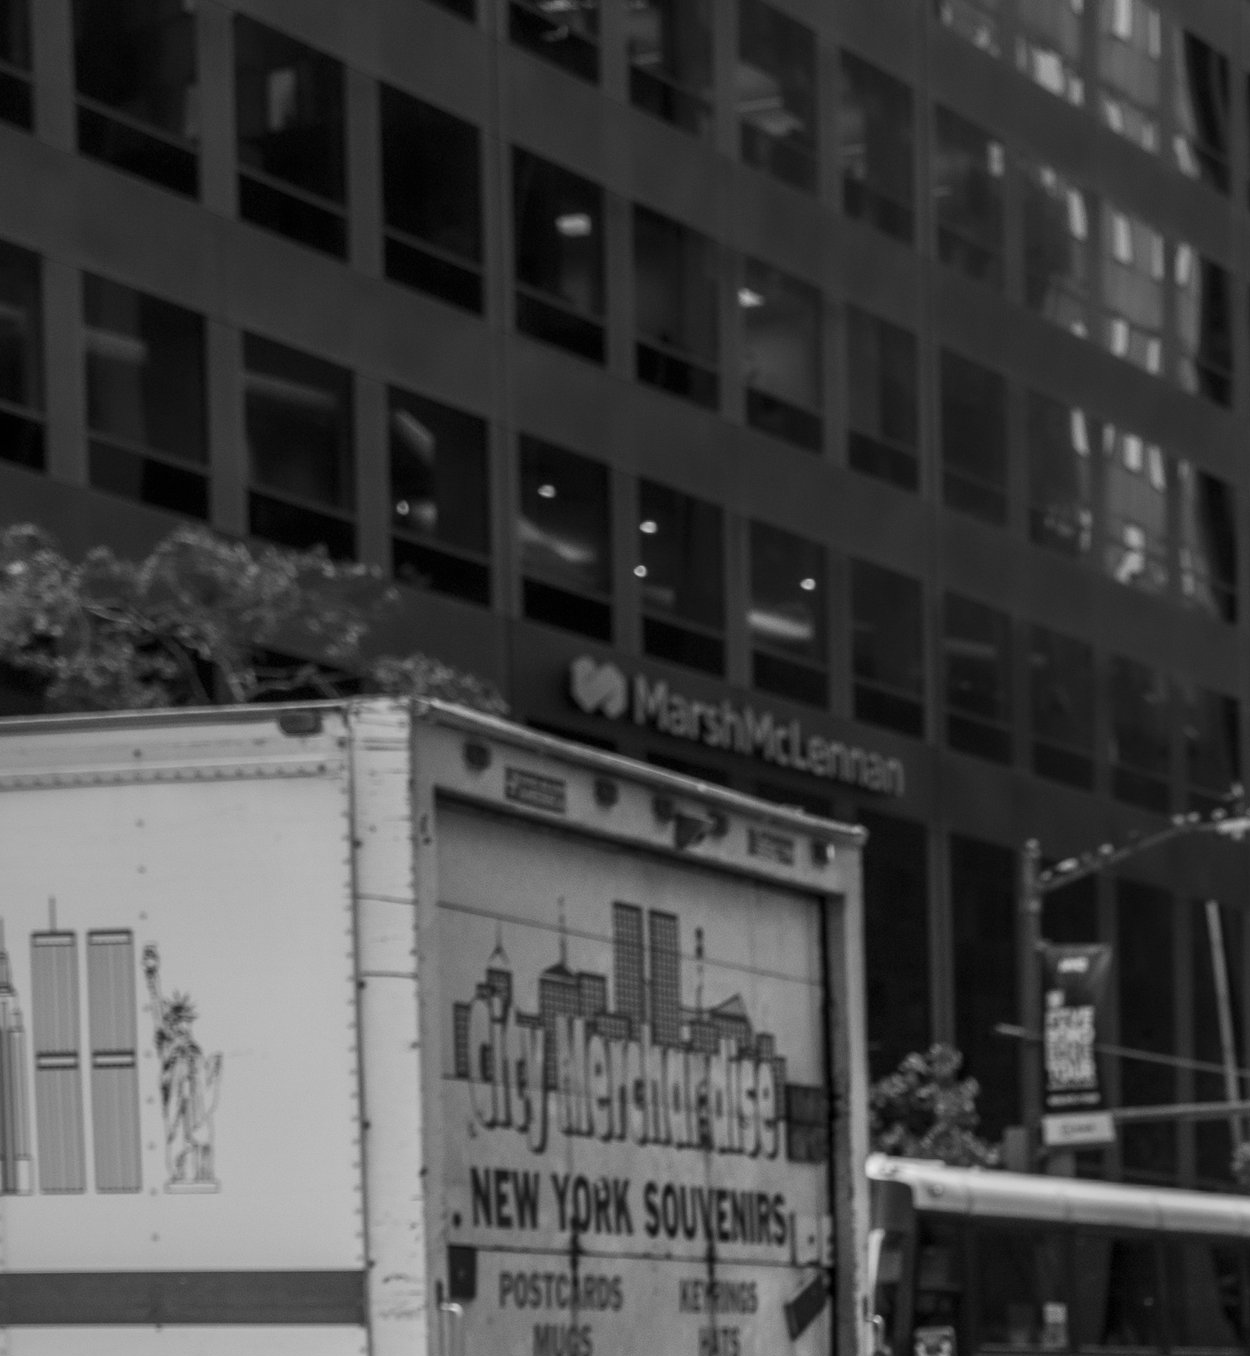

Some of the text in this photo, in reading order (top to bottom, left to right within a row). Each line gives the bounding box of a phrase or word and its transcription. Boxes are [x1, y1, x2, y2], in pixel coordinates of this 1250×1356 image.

[469, 1165, 788, 1247] NEW YORK SOUVENIRS
